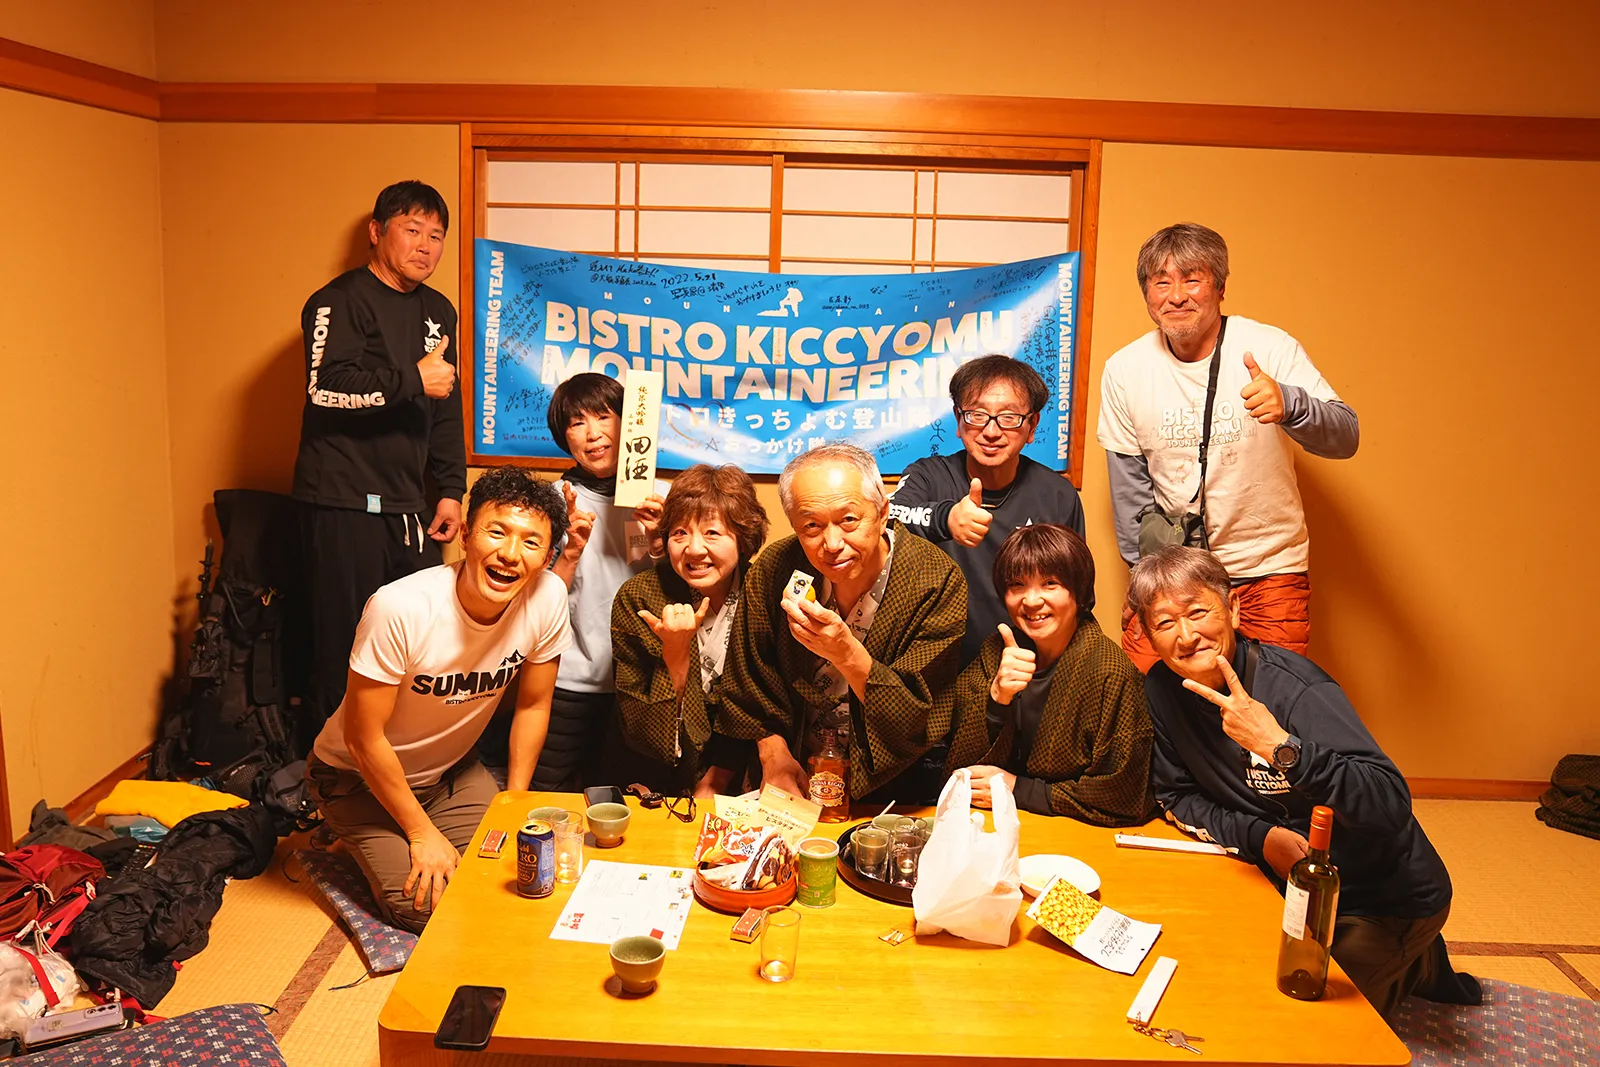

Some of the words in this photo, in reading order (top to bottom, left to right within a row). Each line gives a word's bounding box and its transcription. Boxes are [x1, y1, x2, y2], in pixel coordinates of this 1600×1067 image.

[489, 251, 504, 297] TEAM
[545, 301, 727, 361] BISTRO
[736, 310, 1013, 366] KICCYOMU
[1057, 263, 1072, 412] MOUNTAINEERING
[482, 299, 502, 445] MOUNTAINEERING
[1057, 413, 1069, 459] TEAM
[1162, 401, 1234, 426] BISTO
[625, 436, 652, 481] 田酒
